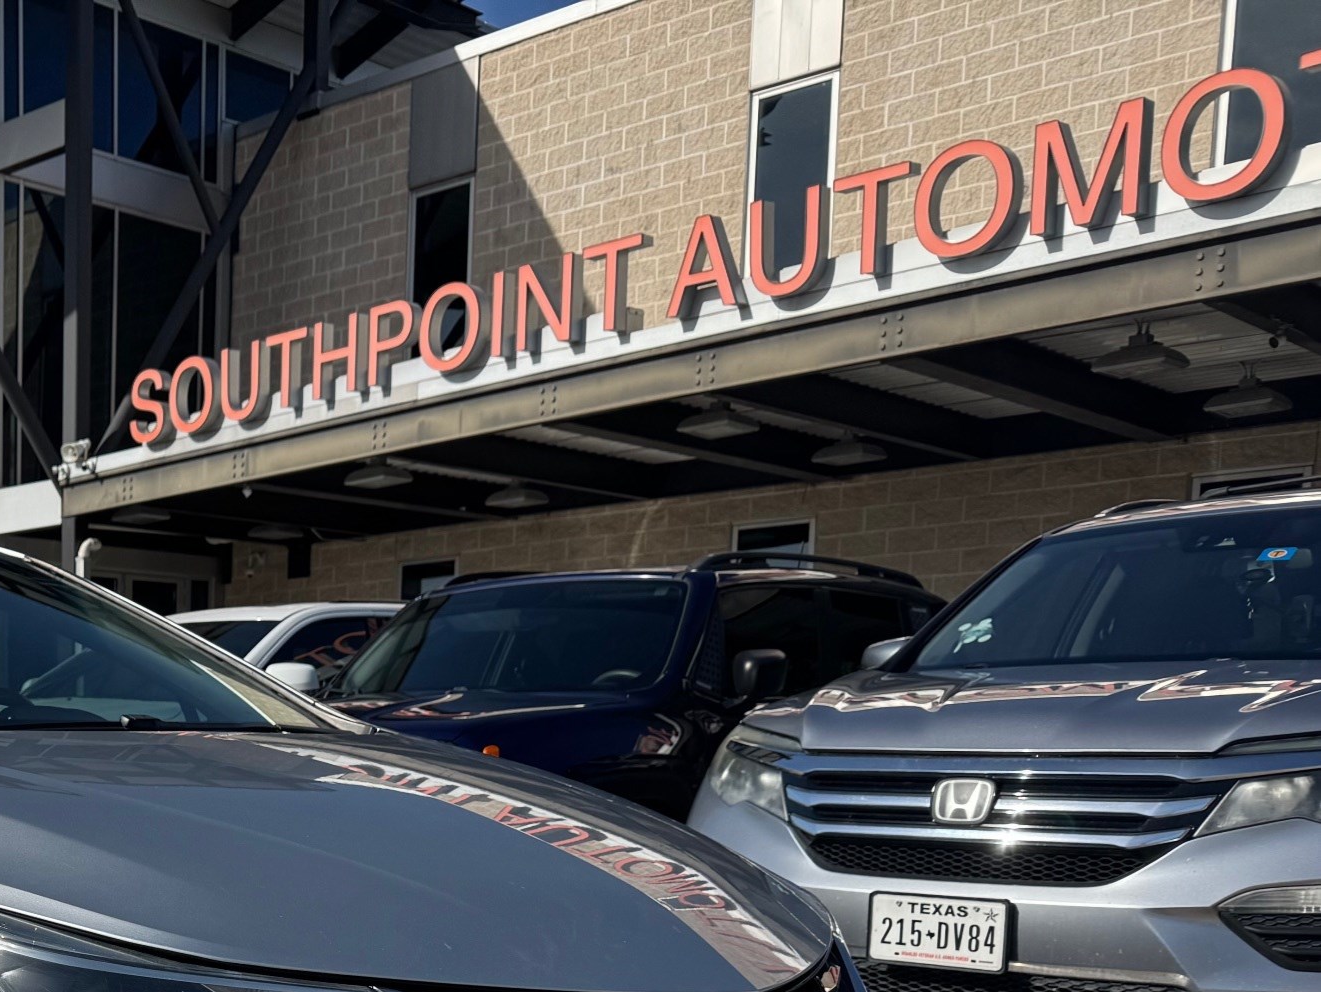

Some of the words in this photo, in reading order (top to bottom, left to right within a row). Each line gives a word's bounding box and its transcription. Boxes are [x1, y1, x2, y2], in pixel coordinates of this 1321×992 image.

[130, 234, 646, 444] SOUTHPOINT
[667, 50, 1321, 317] AUTOMO
[908, 901, 969, 918] TEXAS
[880, 917, 923, 947] 215
[936, 921, 996, 955] DV84
